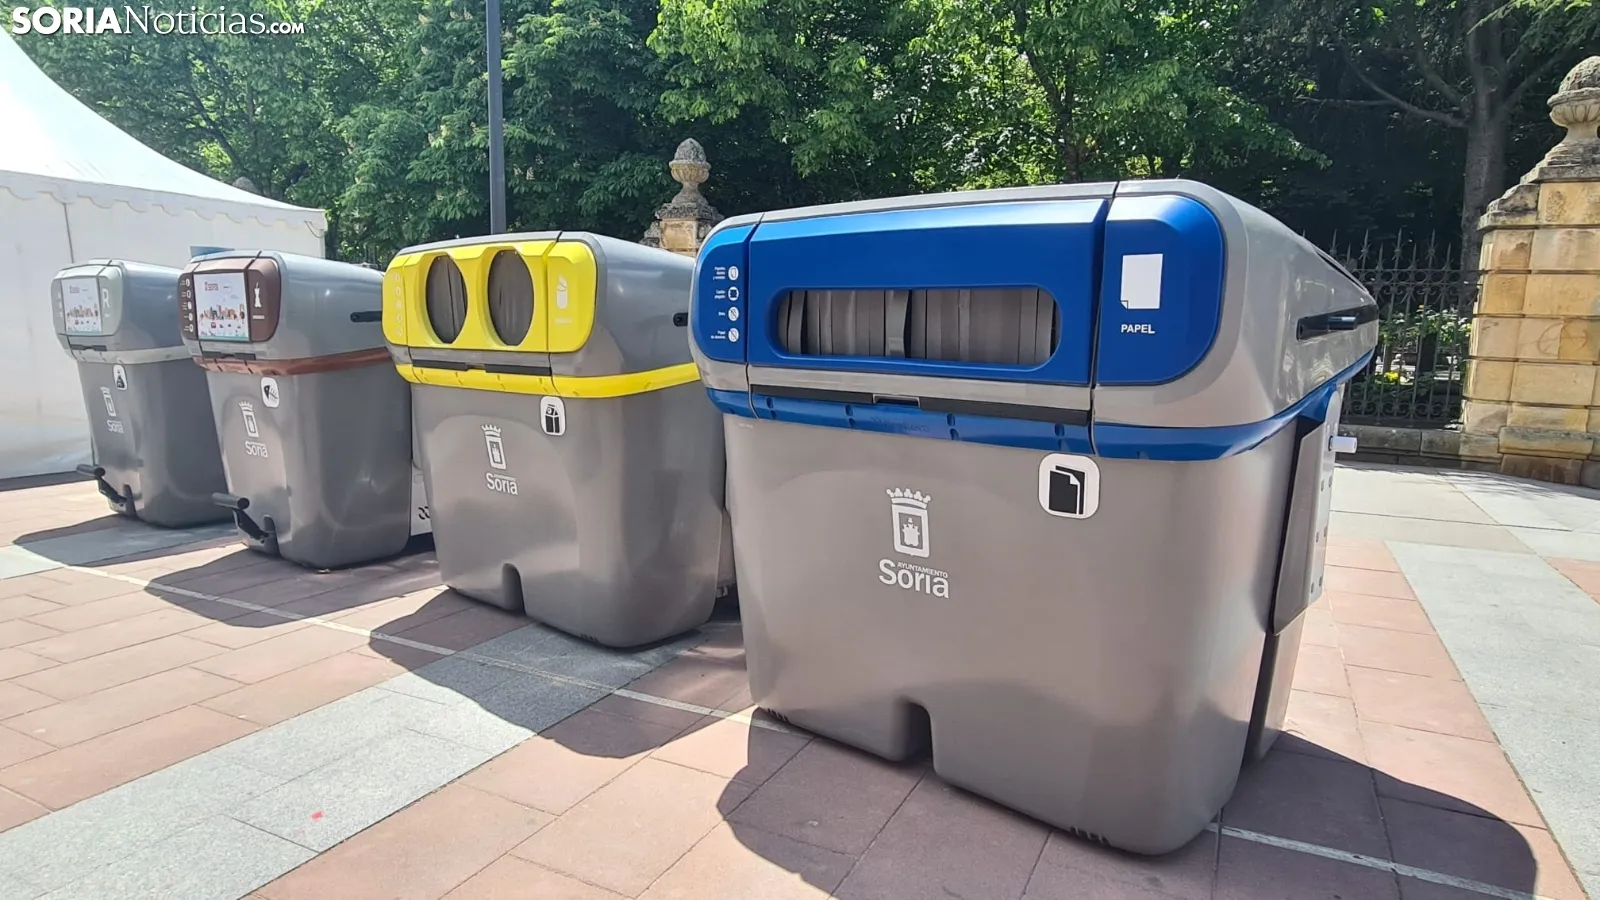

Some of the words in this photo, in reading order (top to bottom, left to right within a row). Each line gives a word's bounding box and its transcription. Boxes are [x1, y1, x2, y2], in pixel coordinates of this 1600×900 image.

[1120, 323, 1156, 335] PAPEL
[245, 440, 269, 458] Soria
[486, 472, 519, 496] Soria
[878, 558, 950, 599] Soria
[897, 561, 949, 579] AYUNTAMIENTO
